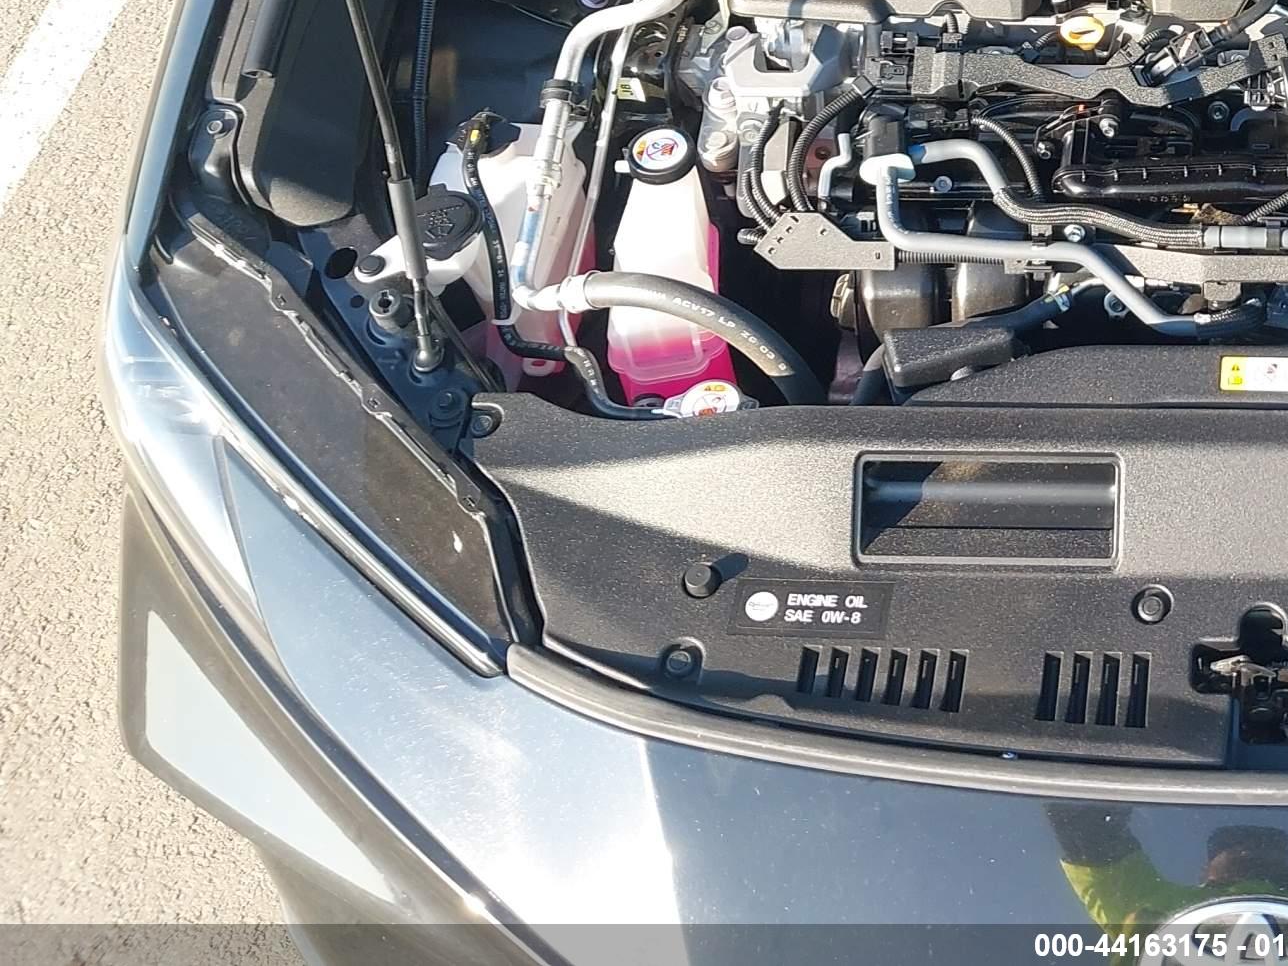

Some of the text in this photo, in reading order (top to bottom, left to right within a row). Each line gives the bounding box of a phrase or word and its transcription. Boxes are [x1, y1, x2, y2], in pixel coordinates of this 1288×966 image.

[787, 593, 839, 607] ENGINE
[845, 594, 868, 608] OIL
[784, 609, 862, 624] SAE 0W-8
